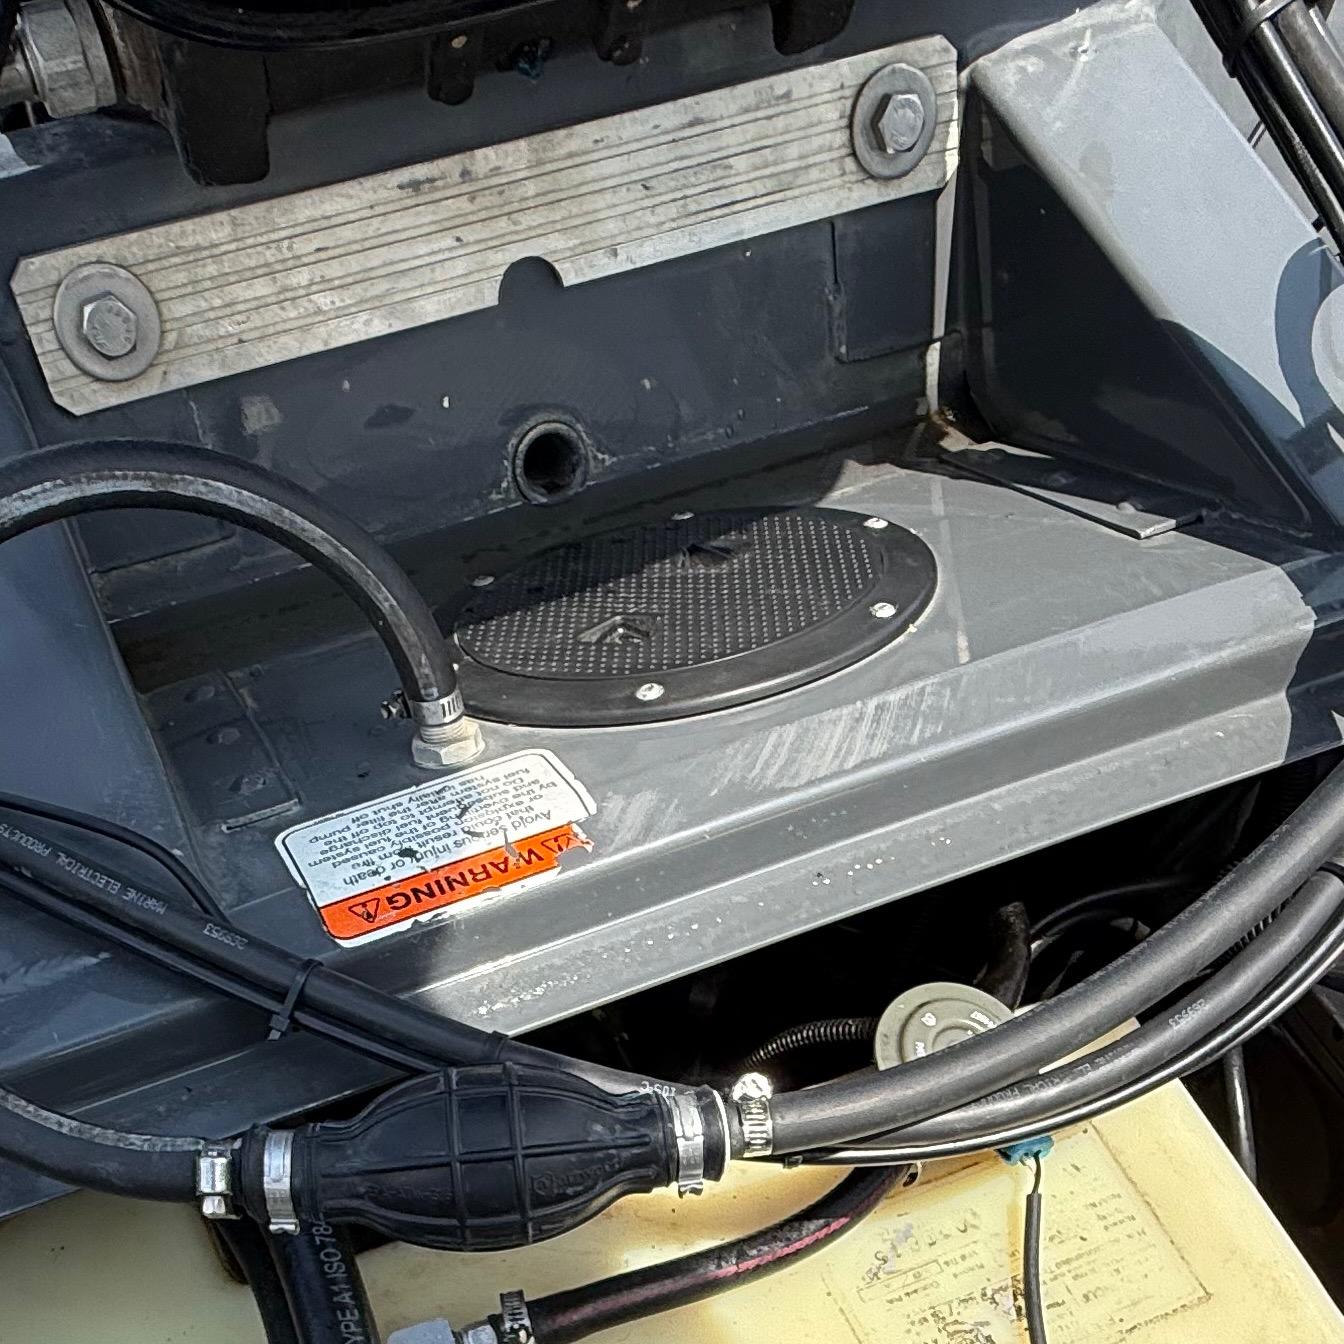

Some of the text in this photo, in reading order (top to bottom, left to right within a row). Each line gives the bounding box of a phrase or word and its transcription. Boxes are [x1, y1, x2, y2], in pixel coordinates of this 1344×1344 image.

[55, 851, 121, 894] ELECTRICAL
[384, 847, 543, 912] WARNING
[320, 1248, 349, 1279] ISO
[330, 1282, 353, 1303] A1
